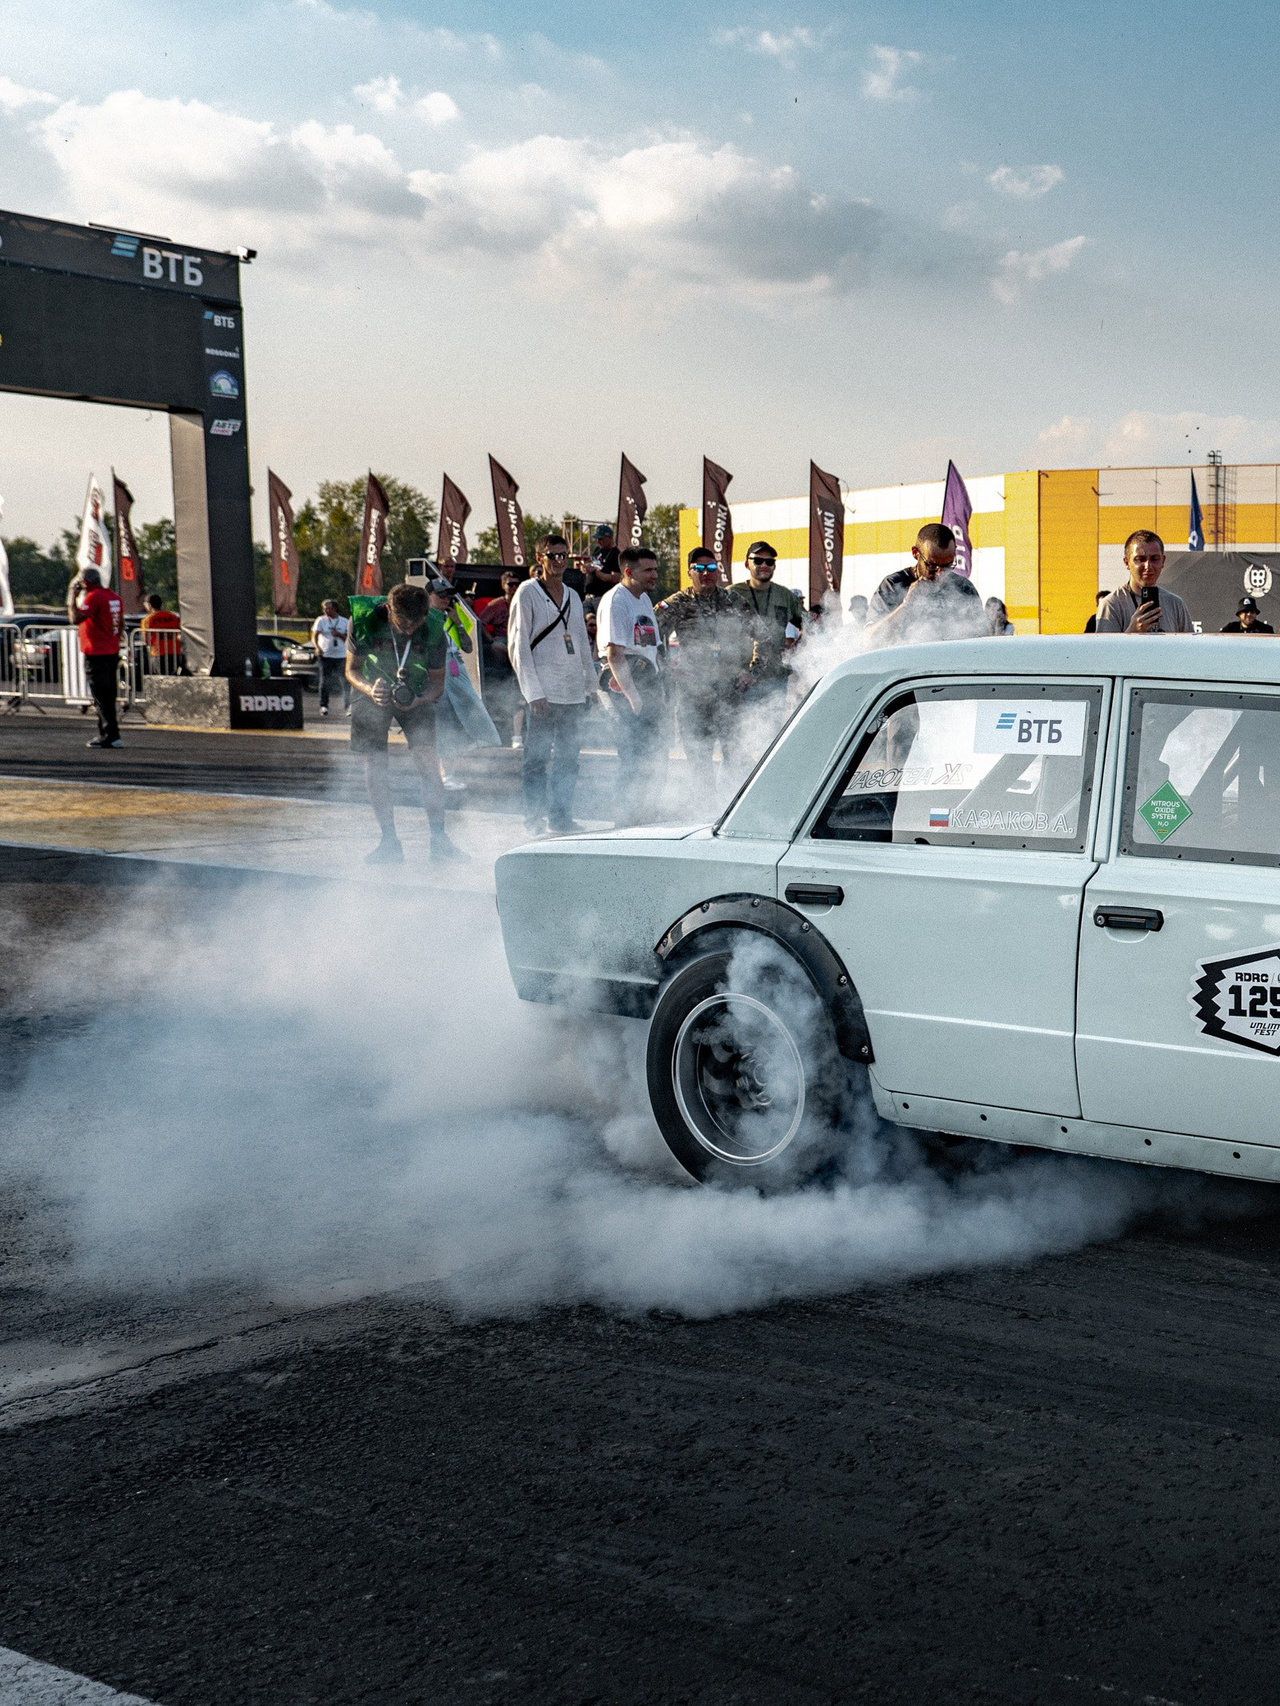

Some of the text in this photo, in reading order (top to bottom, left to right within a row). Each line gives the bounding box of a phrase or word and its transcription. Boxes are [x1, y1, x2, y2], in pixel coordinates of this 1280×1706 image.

[142, 246, 203, 287] ВТБ
[213, 314, 236, 329] ВТБ
[239, 695, 295, 712] RDRC
[1017, 719, 1063, 744] ВТБ
[1150, 800, 1181, 808] NITROUS
[950, 808, 1049, 831] КАЗАКОВ
[1235, 972, 1269, 983] RDRC
[1249, 1022, 1280, 1030] UNLIM
[1254, 1029, 1277, 1037] FEST
